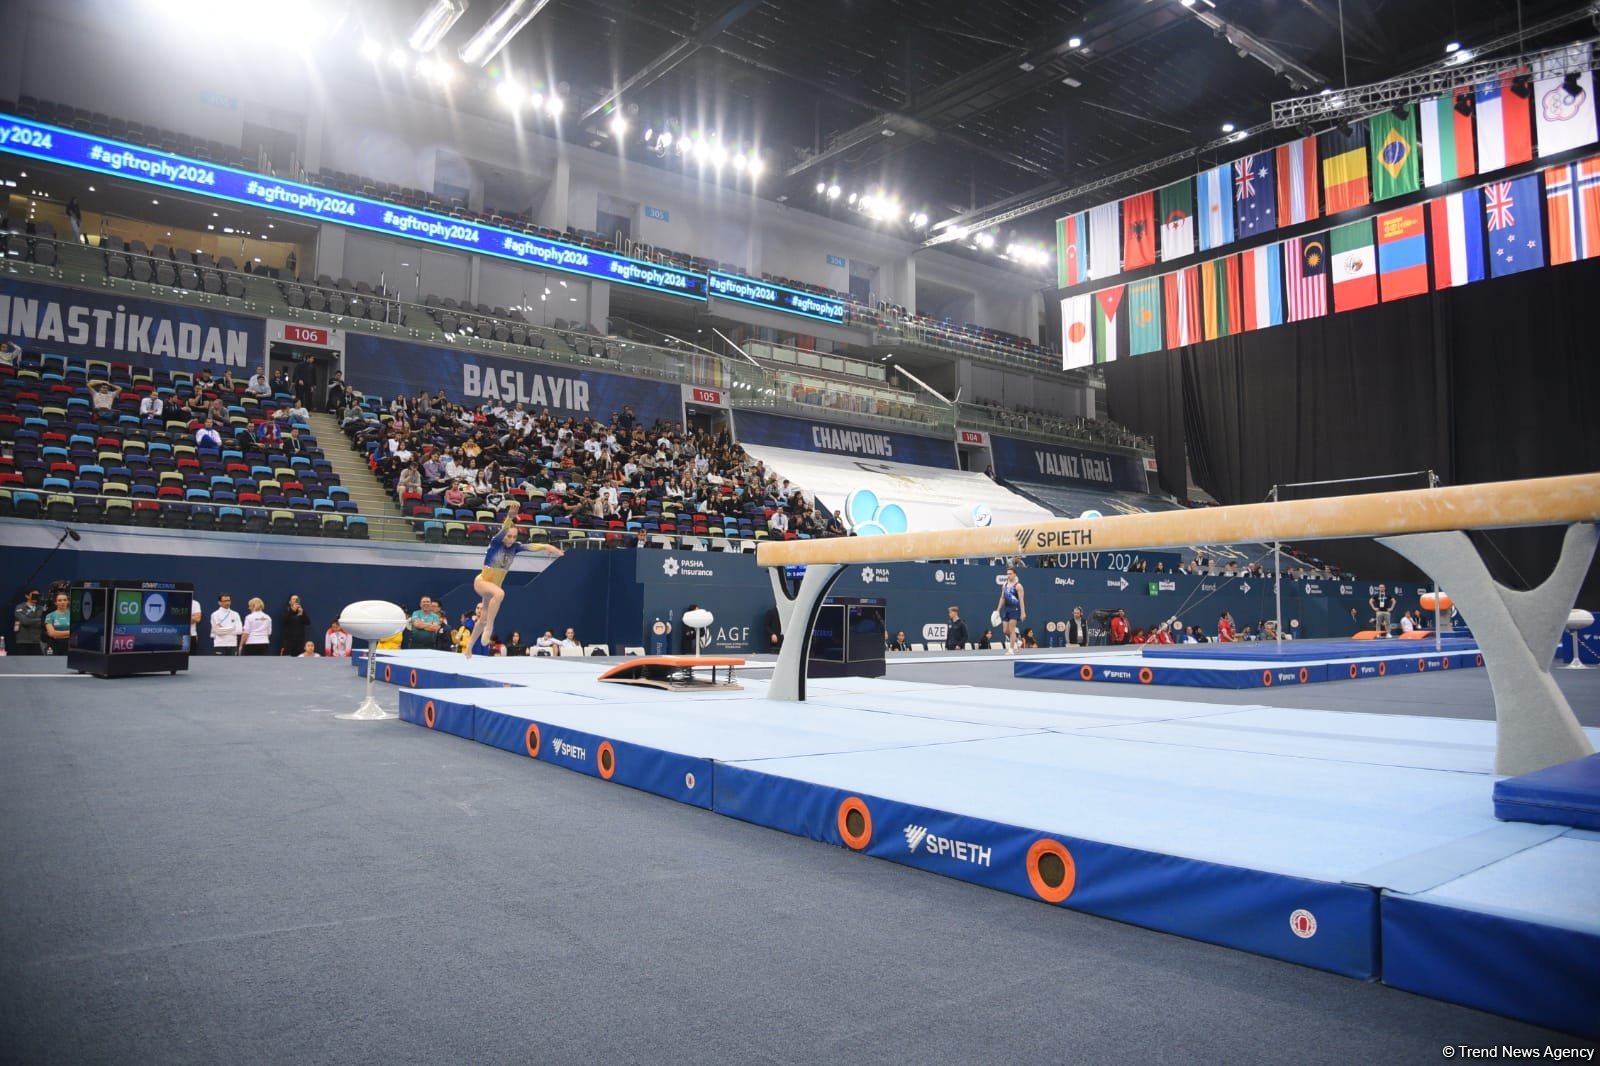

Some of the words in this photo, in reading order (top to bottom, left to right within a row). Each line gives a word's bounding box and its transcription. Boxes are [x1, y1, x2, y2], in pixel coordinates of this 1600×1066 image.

[90, 145, 215, 186] #agftrophy2024
[247, 180, 356, 216] #agftrophy2024
[383, 210, 480, 242] #agftrophy2024
[503, 236, 589, 267] #agftrophy2024
[610, 261, 687, 288] #agftrophy2024
[709, 276, 776, 301] #agftrophy2024
[791, 295, 843, 317] #agftrophy20
[293, 328, 319, 342] 106
[699, 391, 714, 402] 105
[811, 426, 893, 457] CHAMPIONS
[966, 432, 978, 442] 104
[1035, 450, 1080, 478] YALNIZ
[1037, 529, 1092, 548] SPIETH
[681, 559, 704, 568] PASHA
[681, 568, 713, 577] Insurance
[945, 571, 955, 581] LG
[119, 601, 139, 615] GO
[717, 626, 750, 641] AGF
[113, 639, 134, 650] ALG
[561, 742, 586, 761] SPIETH
[926, 833, 992, 868] SPIETH
